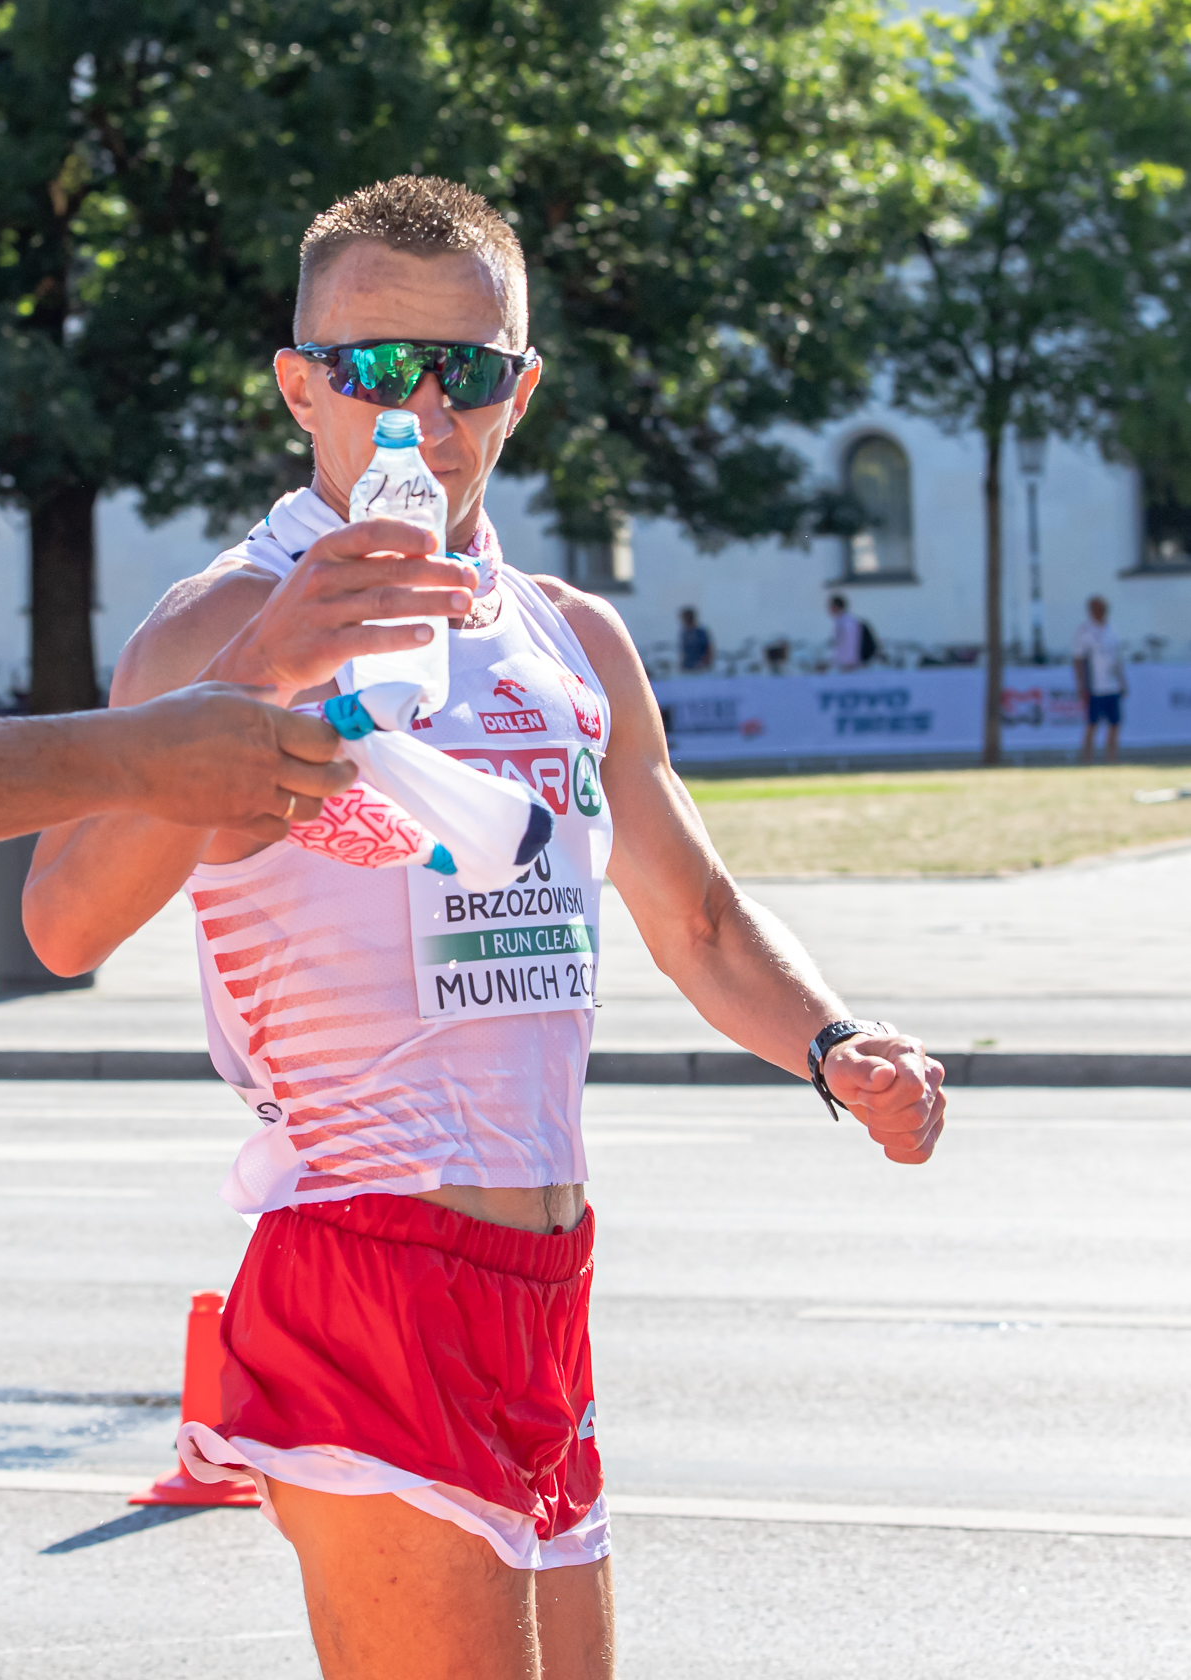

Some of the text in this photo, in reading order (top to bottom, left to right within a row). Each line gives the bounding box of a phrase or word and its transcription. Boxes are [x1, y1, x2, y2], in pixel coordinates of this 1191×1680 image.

[483, 712, 543, 731] ORLEN
[445, 887, 584, 922] BRZOZOWSKI
[479, 935, 486, 956] I
[493, 931, 532, 954] RUN
[435, 965, 560, 1010] MUNICH
